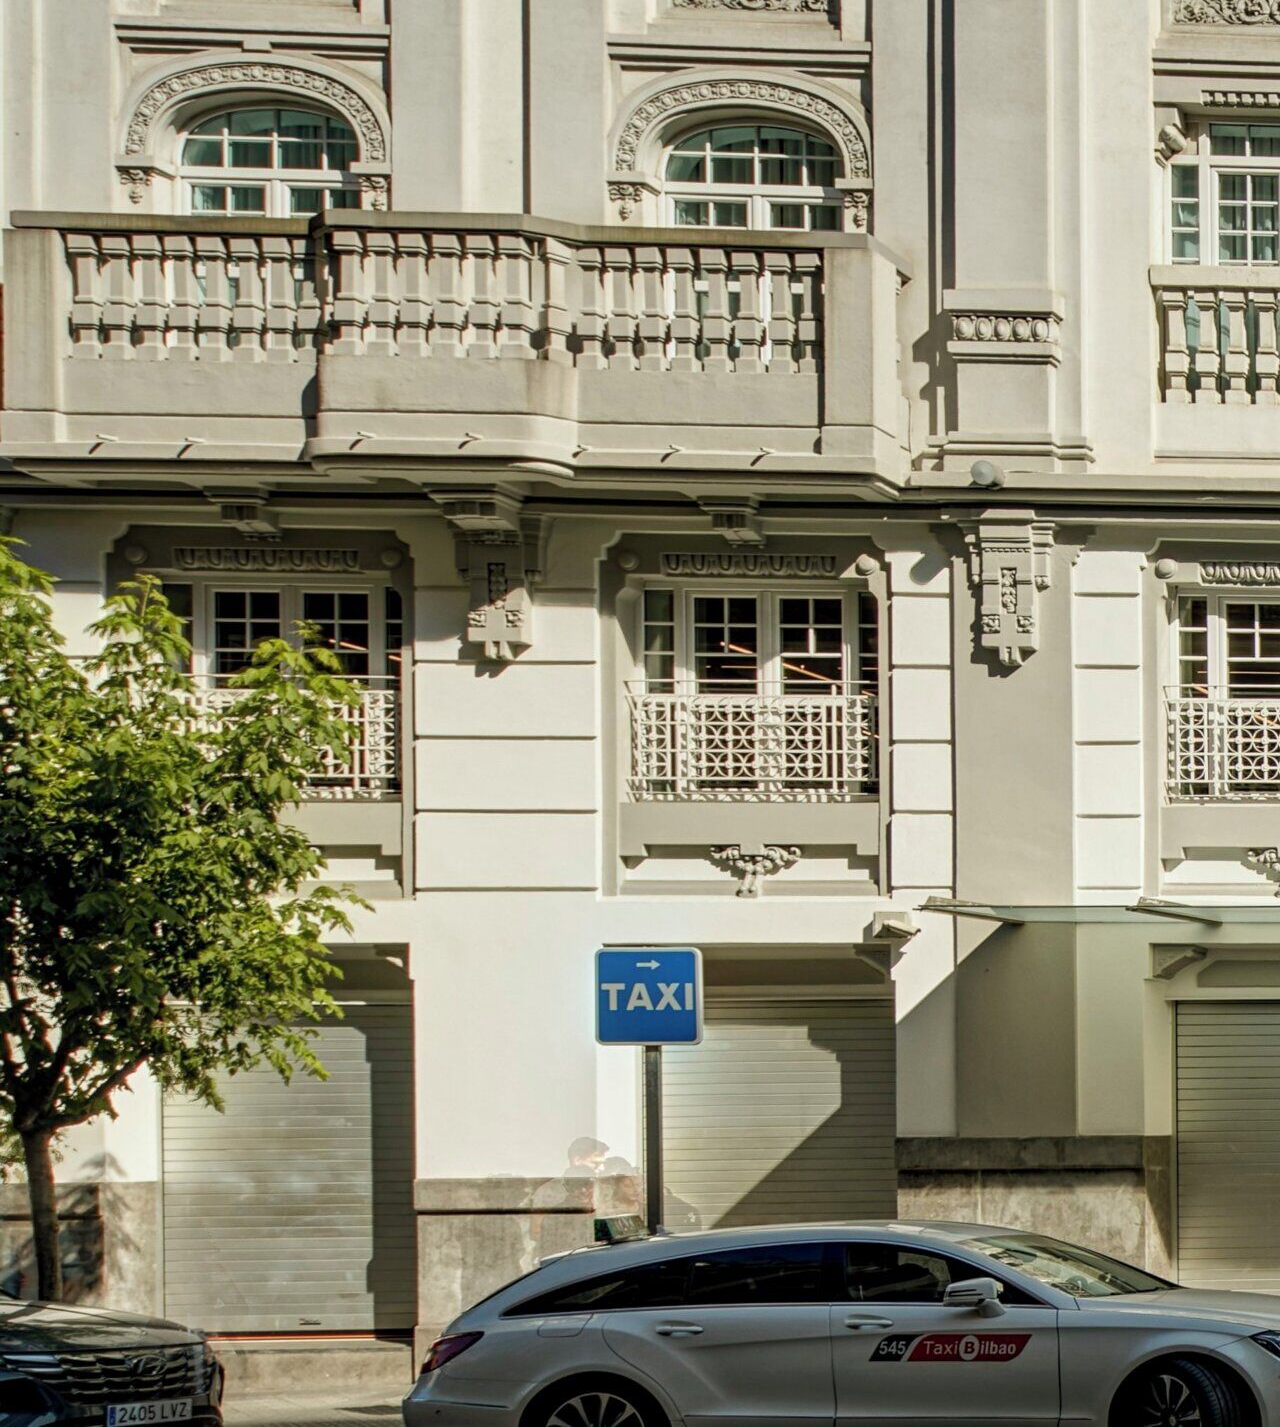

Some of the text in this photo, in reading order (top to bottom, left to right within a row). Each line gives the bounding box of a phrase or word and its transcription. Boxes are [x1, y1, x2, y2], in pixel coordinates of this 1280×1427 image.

[601, 982, 694, 1011] TAXI
[879, 1340, 907, 1355] 545
[118, 1402, 187, 1423] 2405 LVZ
